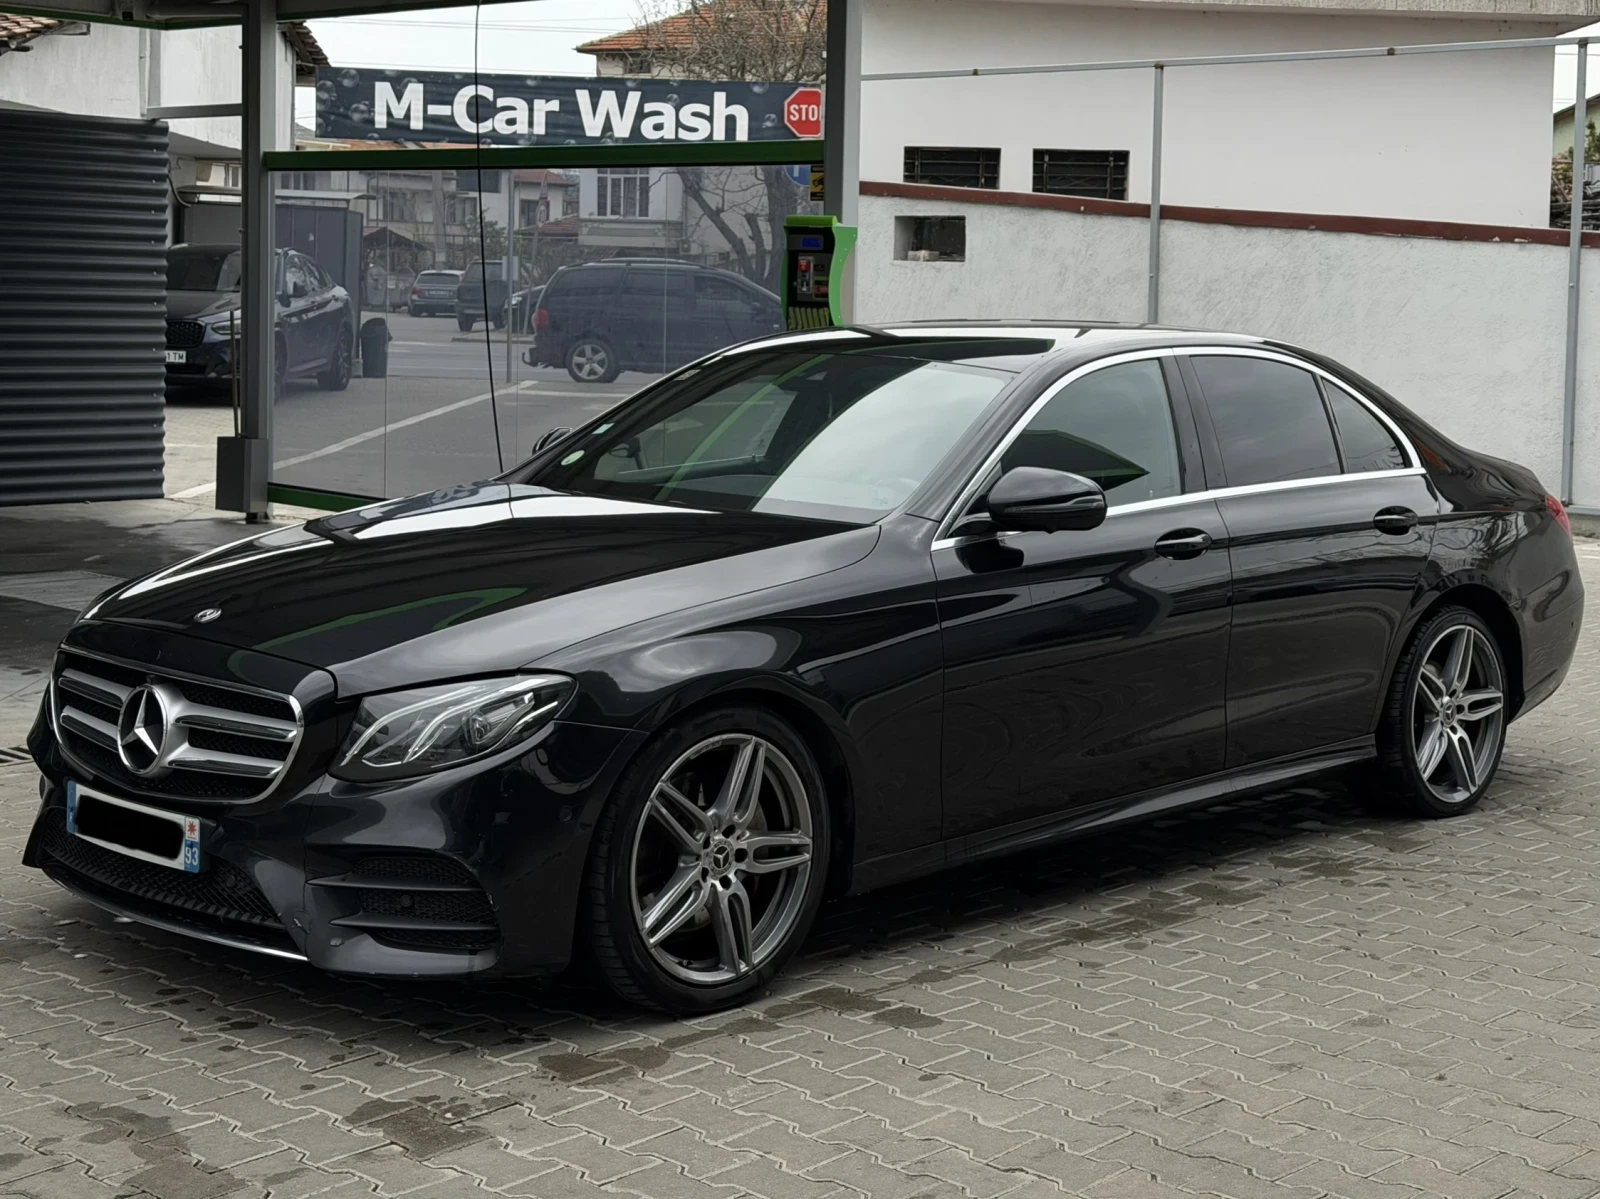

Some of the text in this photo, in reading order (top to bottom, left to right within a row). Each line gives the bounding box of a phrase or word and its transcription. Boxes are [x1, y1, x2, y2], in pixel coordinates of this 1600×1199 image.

[373, 81, 749, 142] M-Car Wash
[173, 352, 184, 361] TM
[185, 847, 198, 866] 93
